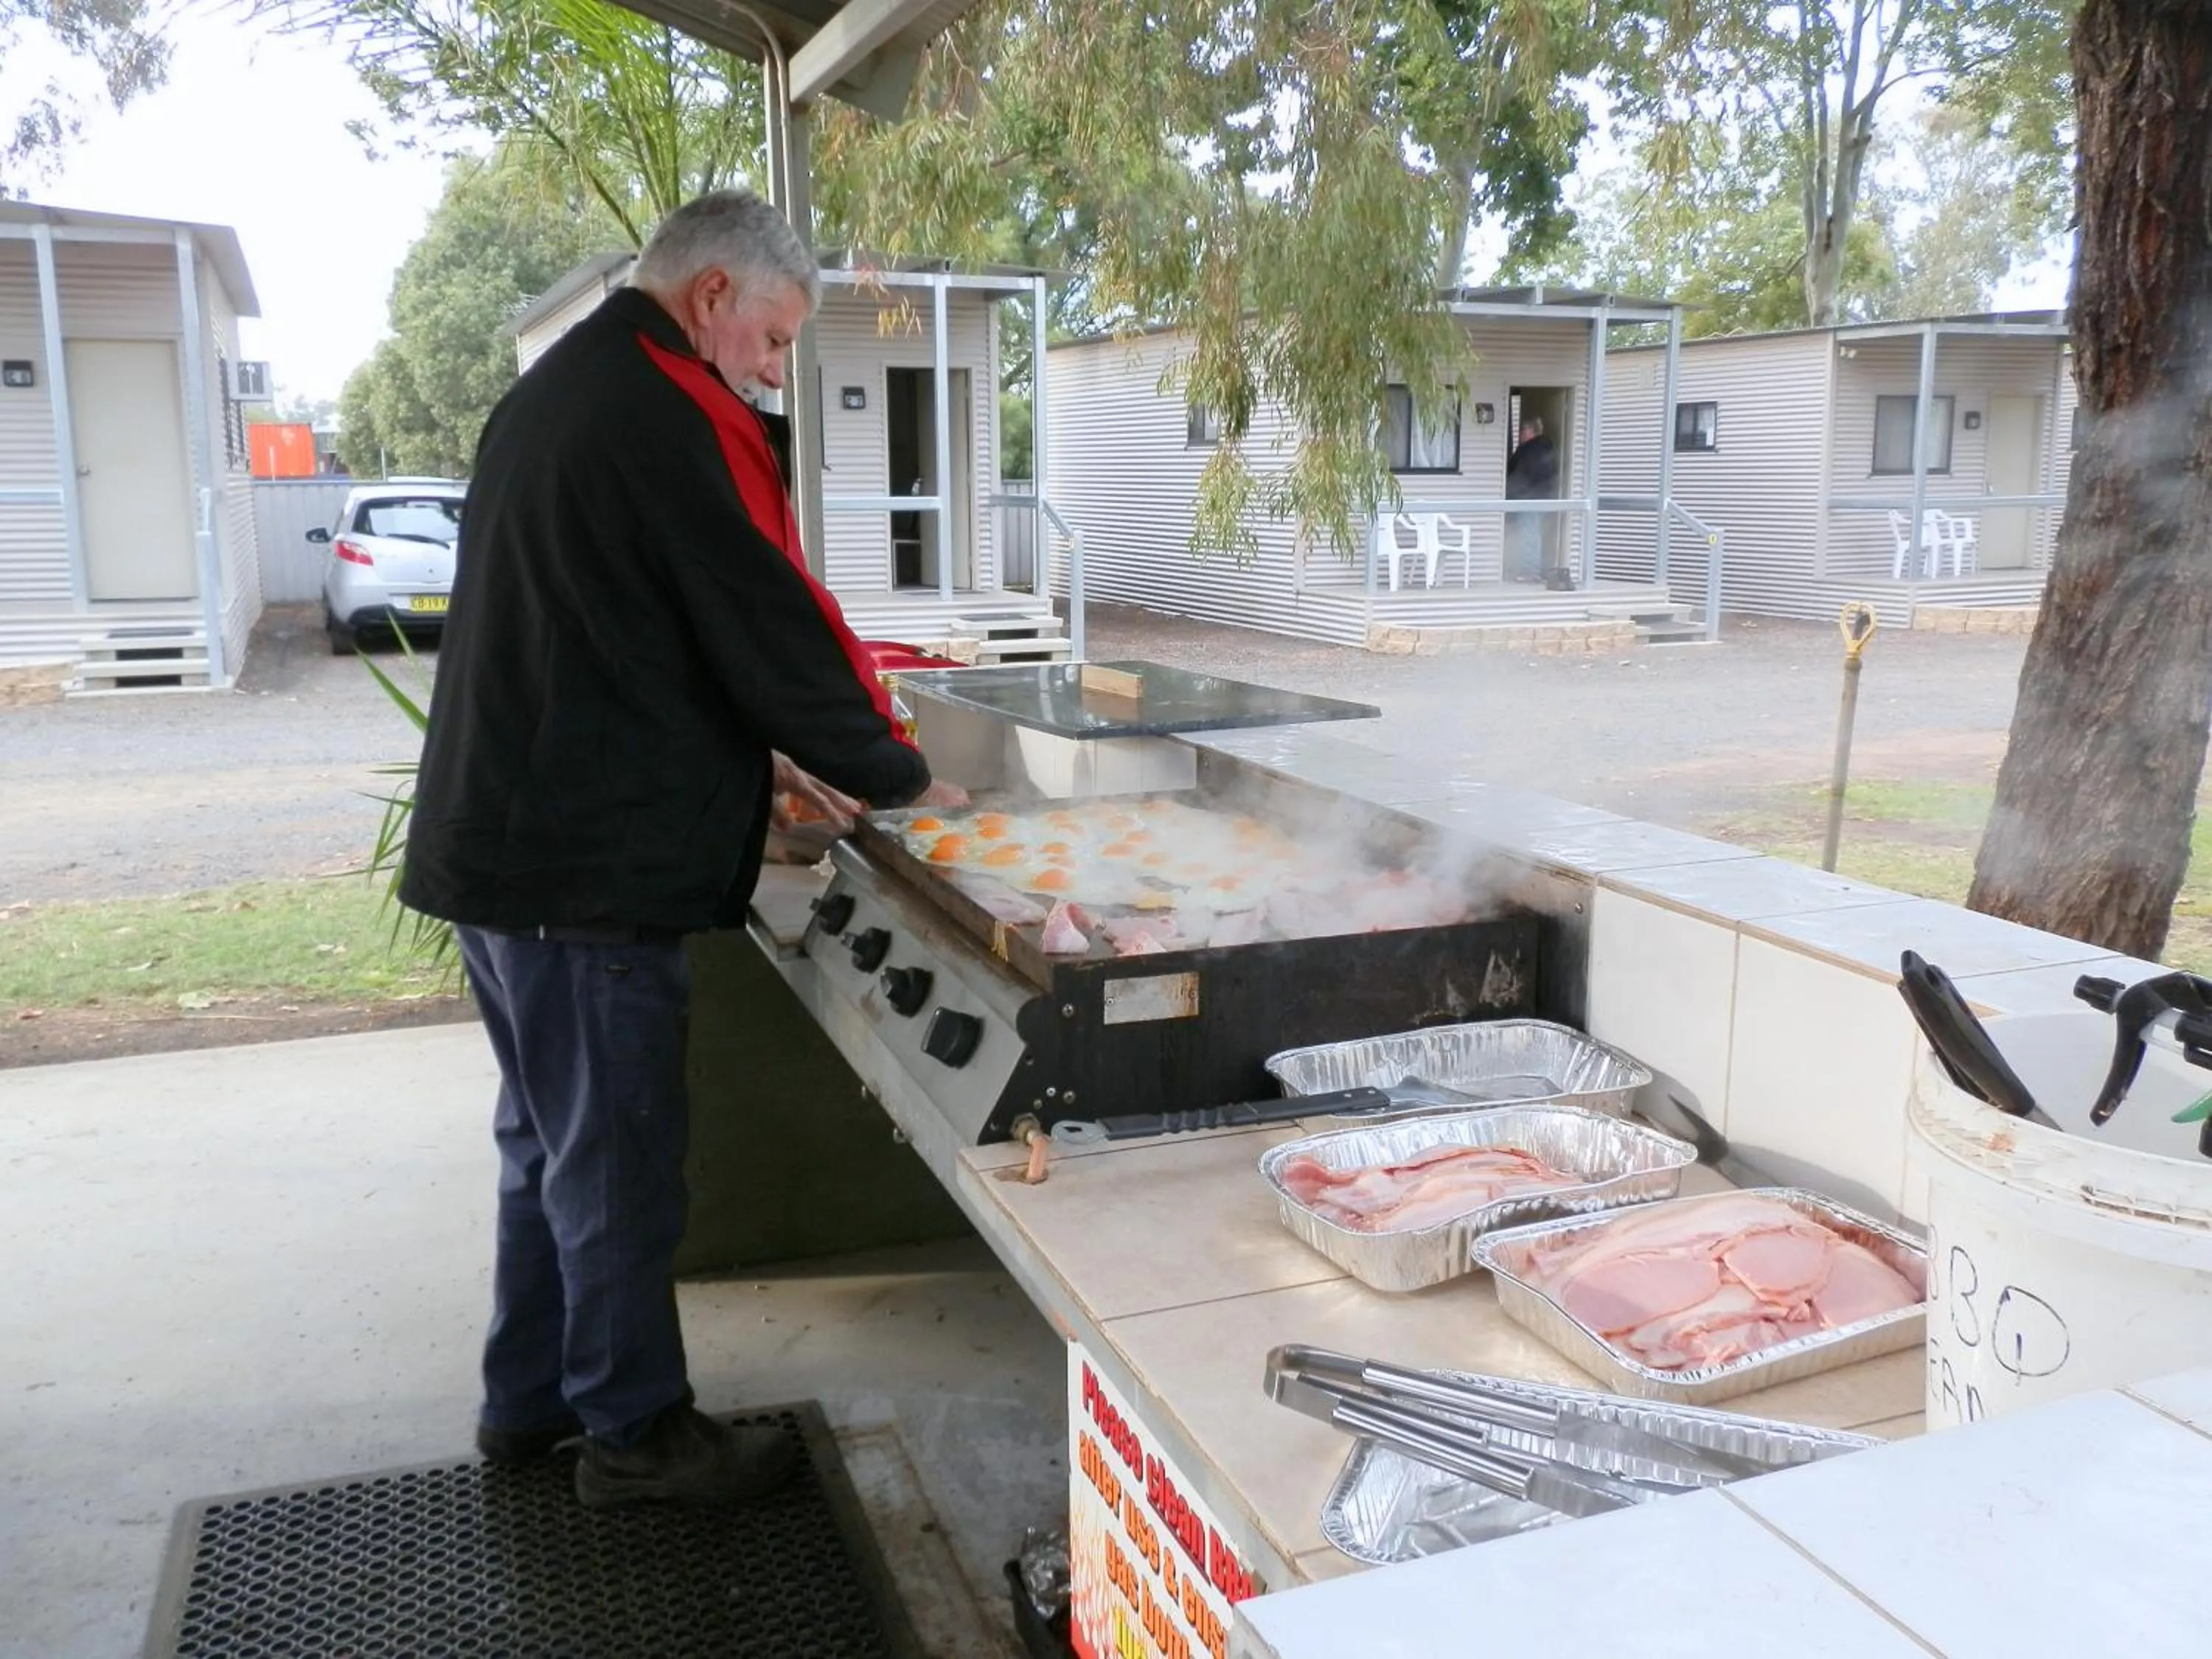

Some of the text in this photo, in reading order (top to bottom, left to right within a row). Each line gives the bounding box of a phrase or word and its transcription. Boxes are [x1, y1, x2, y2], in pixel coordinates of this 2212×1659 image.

[1082, 1360, 1144, 1483] Please
[1079, 1429, 1228, 1658] after use & ens
[1106, 1531, 1138, 1613] gas
